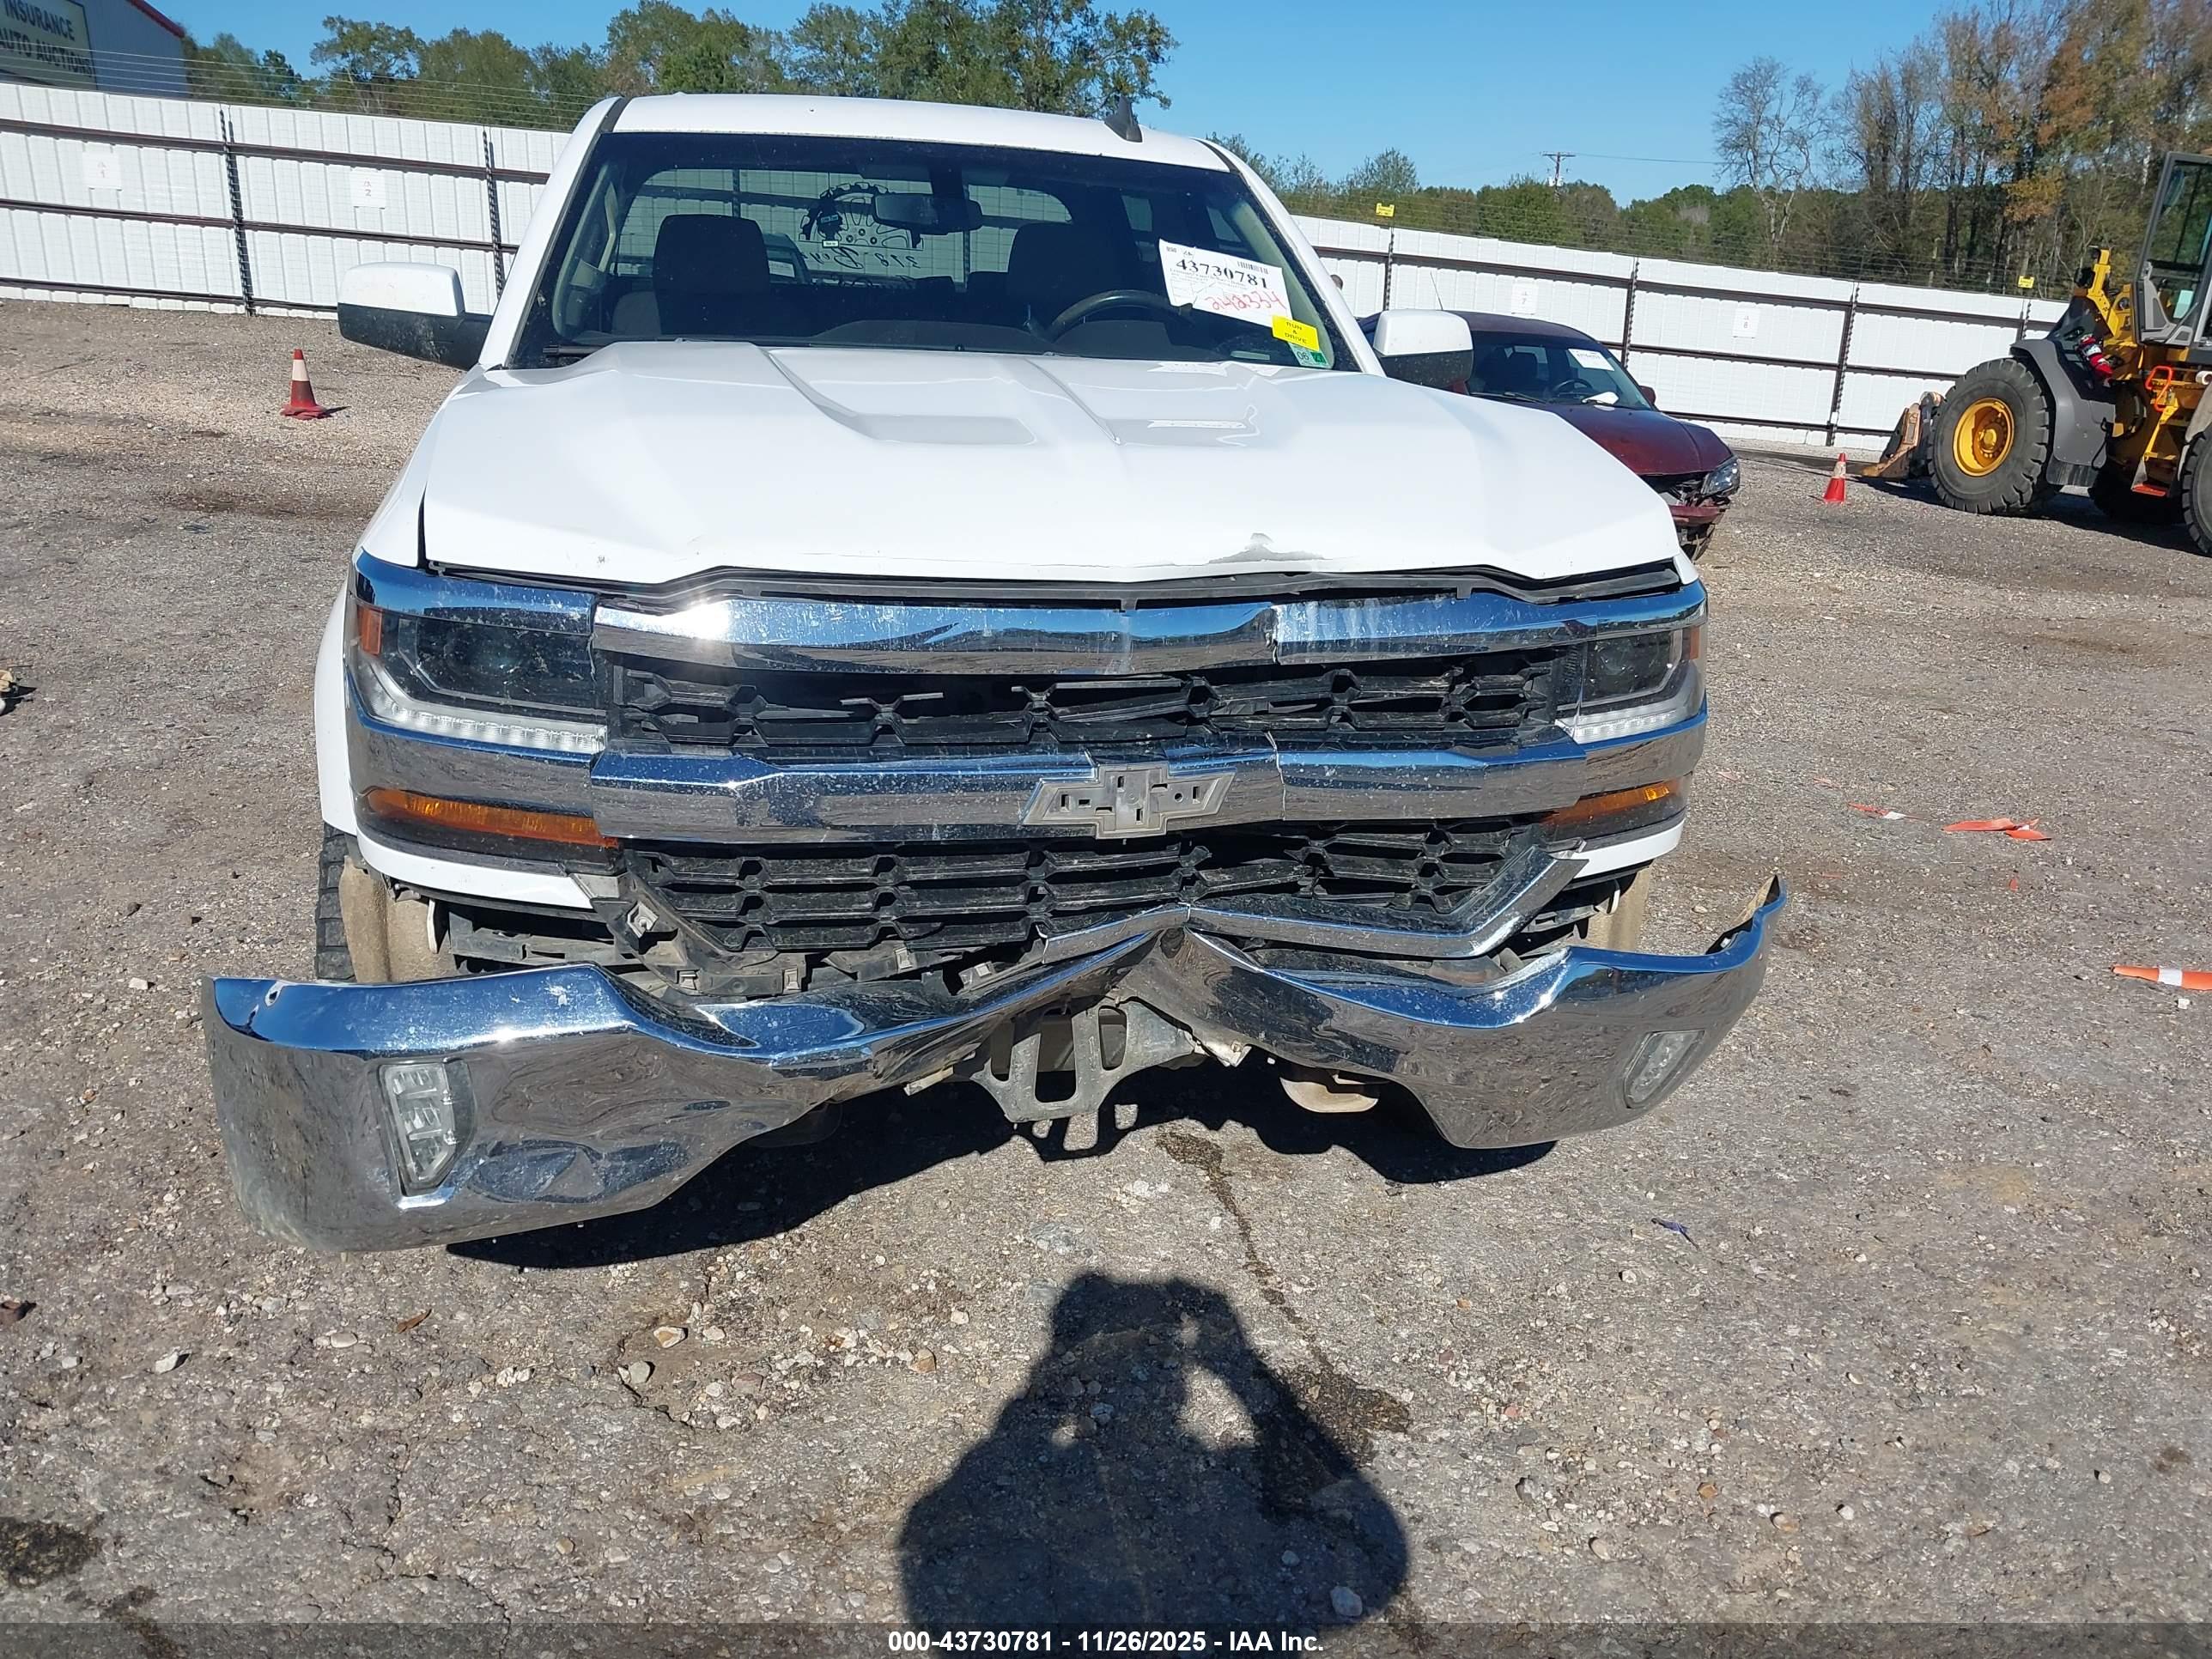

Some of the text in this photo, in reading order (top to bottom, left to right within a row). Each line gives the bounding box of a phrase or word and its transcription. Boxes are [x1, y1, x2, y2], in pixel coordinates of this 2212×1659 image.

[3, 0, 75, 41] INSURANCE
[36, 39, 92, 78] AUCTIONS
[1176, 258, 1267, 289] 43730781
[1285, 321, 1303, 331] RUN
[1285, 332, 1307, 344] DRIVE
